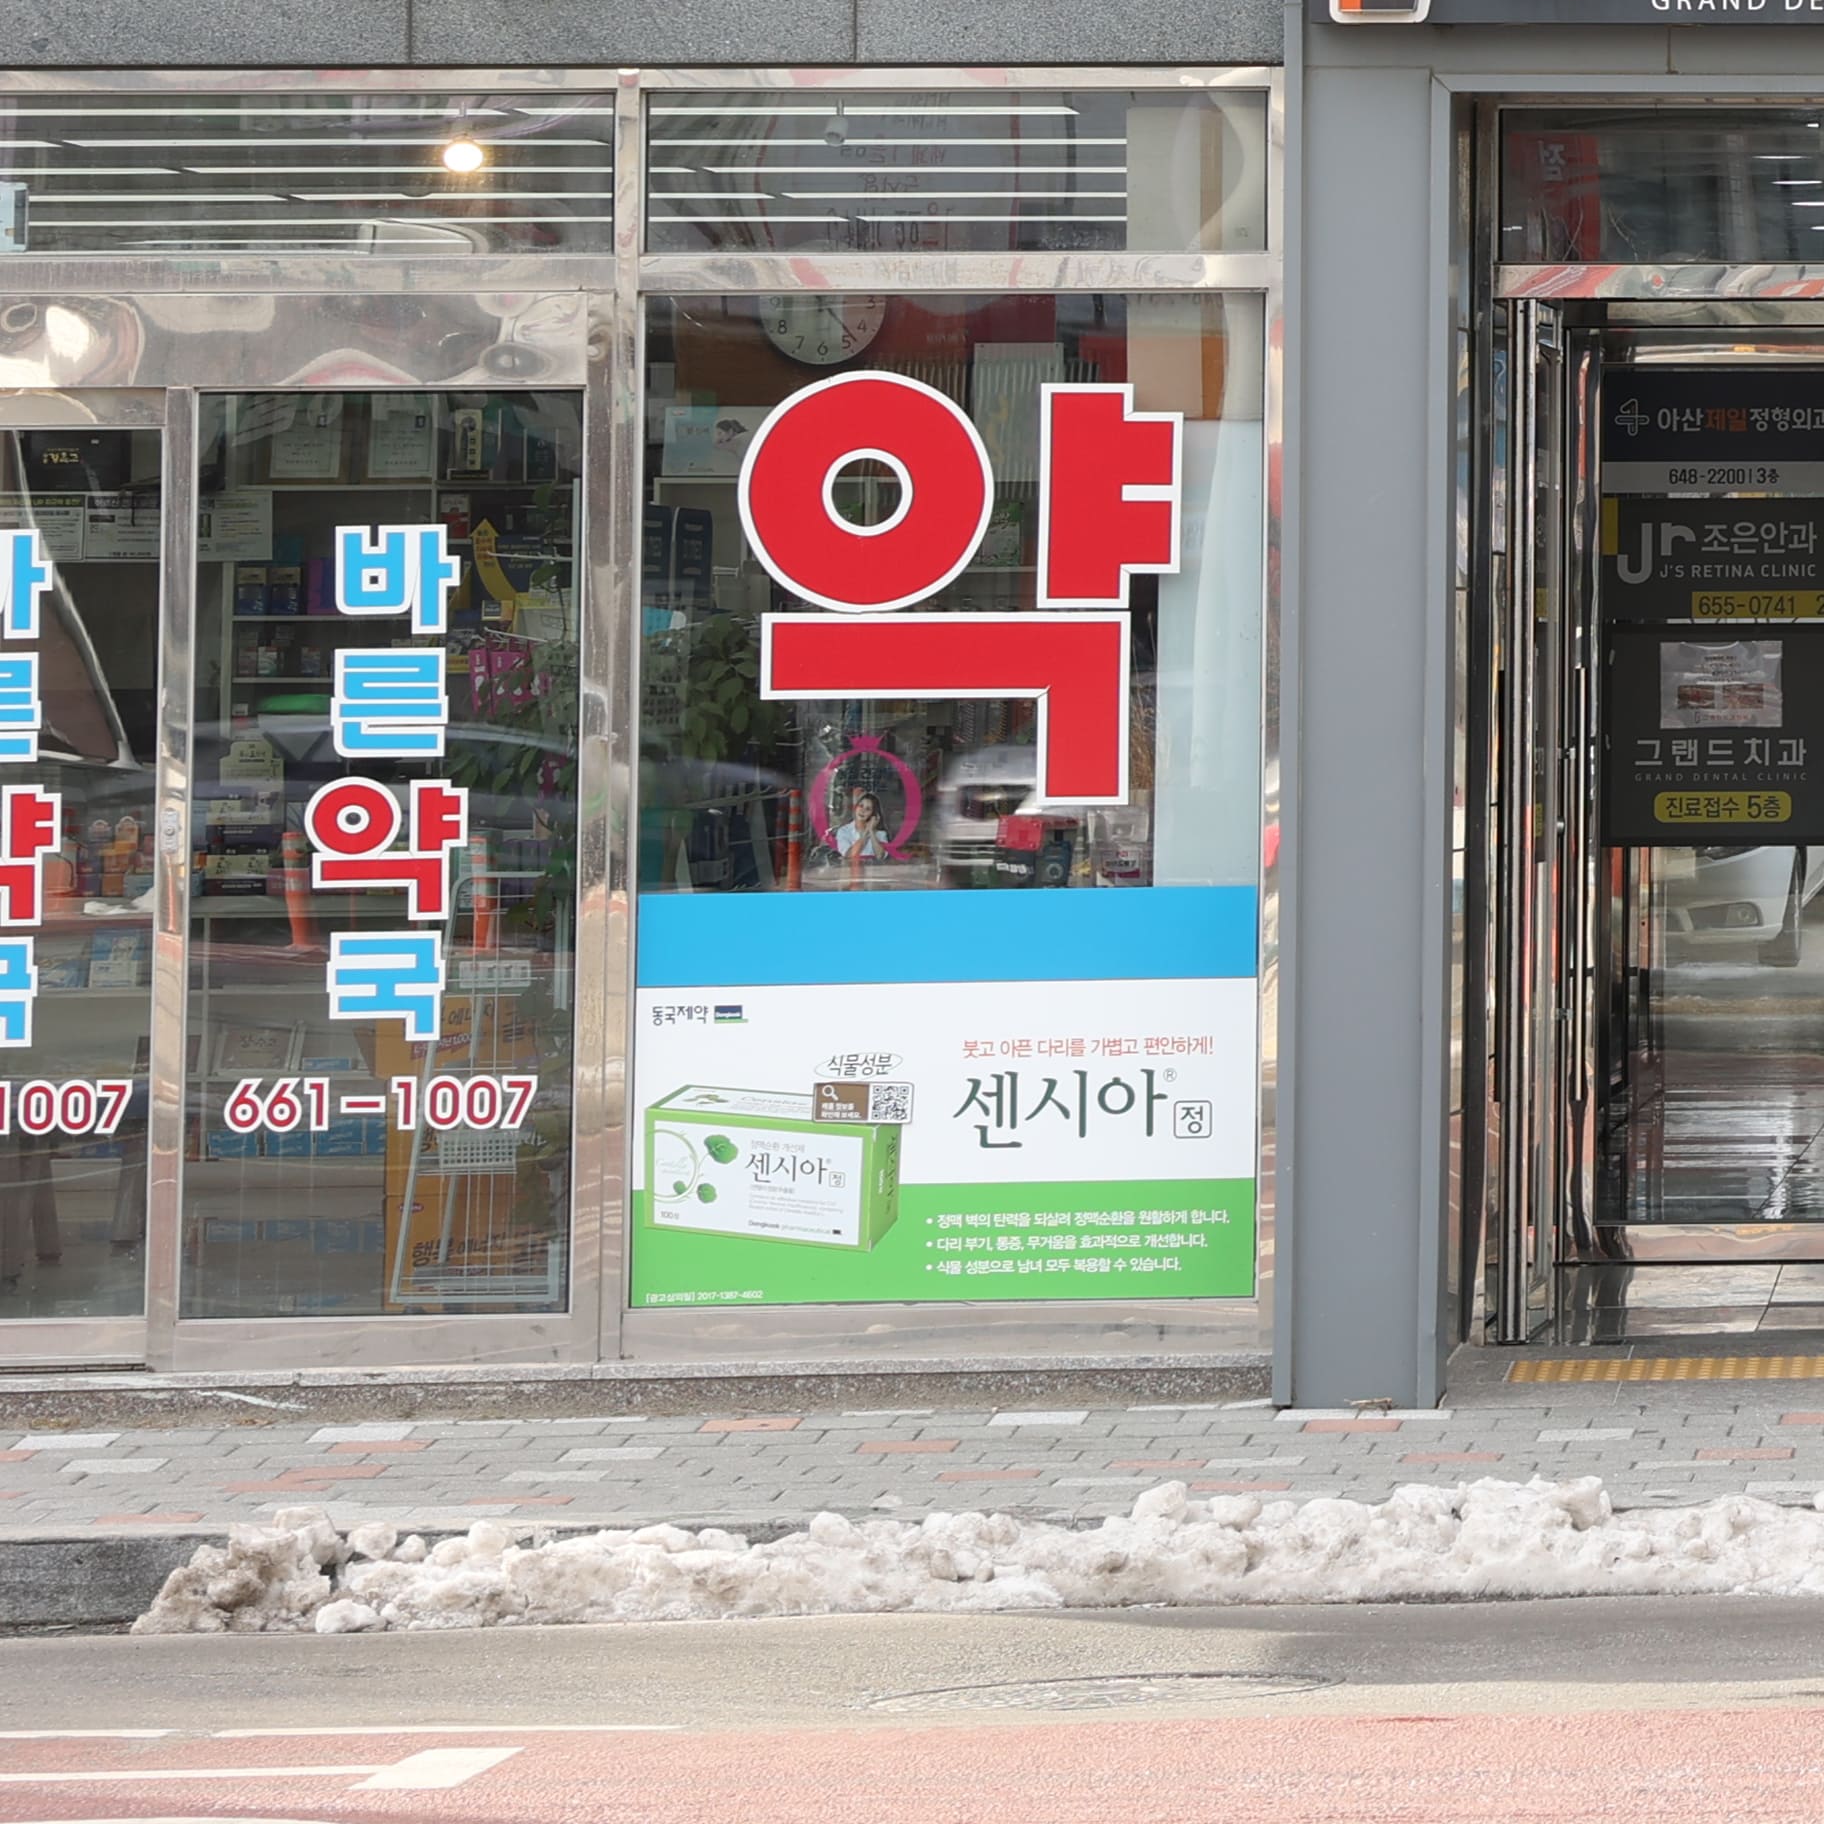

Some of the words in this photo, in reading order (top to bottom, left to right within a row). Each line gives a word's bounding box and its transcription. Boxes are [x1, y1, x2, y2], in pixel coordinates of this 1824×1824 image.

[1668, 467, 1747, 486] 648-2200
[1756, 467, 1780, 485] 3층
[1701, 521, 1818, 555] 조은안과
[1691, 563, 1755, 578] RETINA
[1760, 563, 1817, 578] CLINIC
[737, 369, 1185, 806] 약
[1699, 594, 1797, 616] 655-0741
[1634, 737, 1808, 768] 그랜드치과
[305, 524, 468, 1042] 바른약국
[1634, 772, 1684, 782] GRAND
[1693, 772, 1749, 782] DENTAL
[1757, 772, 1808, 782] CLINIC
[1665, 797, 1741, 820] 진료접수
[1746, 795, 1782, 820] 5층
[651, 1004, 709, 1026] 동국제약
[962, 1039, 996, 1059] 붓고
[1000, 1038, 1033, 1058] 아픈
[1037, 1037, 1086, 1057] 다리를
[1091, 1036, 1139, 1056] 가볍고
[1144, 1035, 1214, 1055] 편안하게!
[827, 1053, 892, 1076] 식물성분
[224, 1074, 538, 1133] 661-1007
[952, 1068, 1169, 1148] 센시아
[1180, 1105, 1204, 1134] 정
[745, 1152, 828, 1185] 센시아
[936, 1213, 963, 1229] 정맥
[965, 1213, 991, 1228] 벽의
[993, 1212, 1031, 1228] 탄력을
[1034, 1211, 1071, 1227] 되살려
[1074, 1210, 1136, 1226] 정맥순환을
[1138, 1210, 1188, 1225] 원활하게
[1190, 1209, 1230, 1225] 합니다.
[936, 1237, 962, 1251] 다리
[965, 1236, 993, 1252] 부기,
[995, 1236, 1025, 1251] 통증,
[1027, 1235, 1077, 1250] 무거움을
[1079, 1234, 1142, 1249] 효과적으로
[1144, 1233, 1209, 1248] 개선합니다.
[936, 1260, 963, 1275] 식물
[965, 1259, 1015, 1275] 성분으로
[1017, 1258, 1043, 1273] 남녀
[1045, 1258, 1071, 1273] 모두
[1073, 1258, 1111, 1273] 복용할
[1113, 1258, 1128, 1272] 수
[1130, 1257, 1182, 1272] 있습니다.
